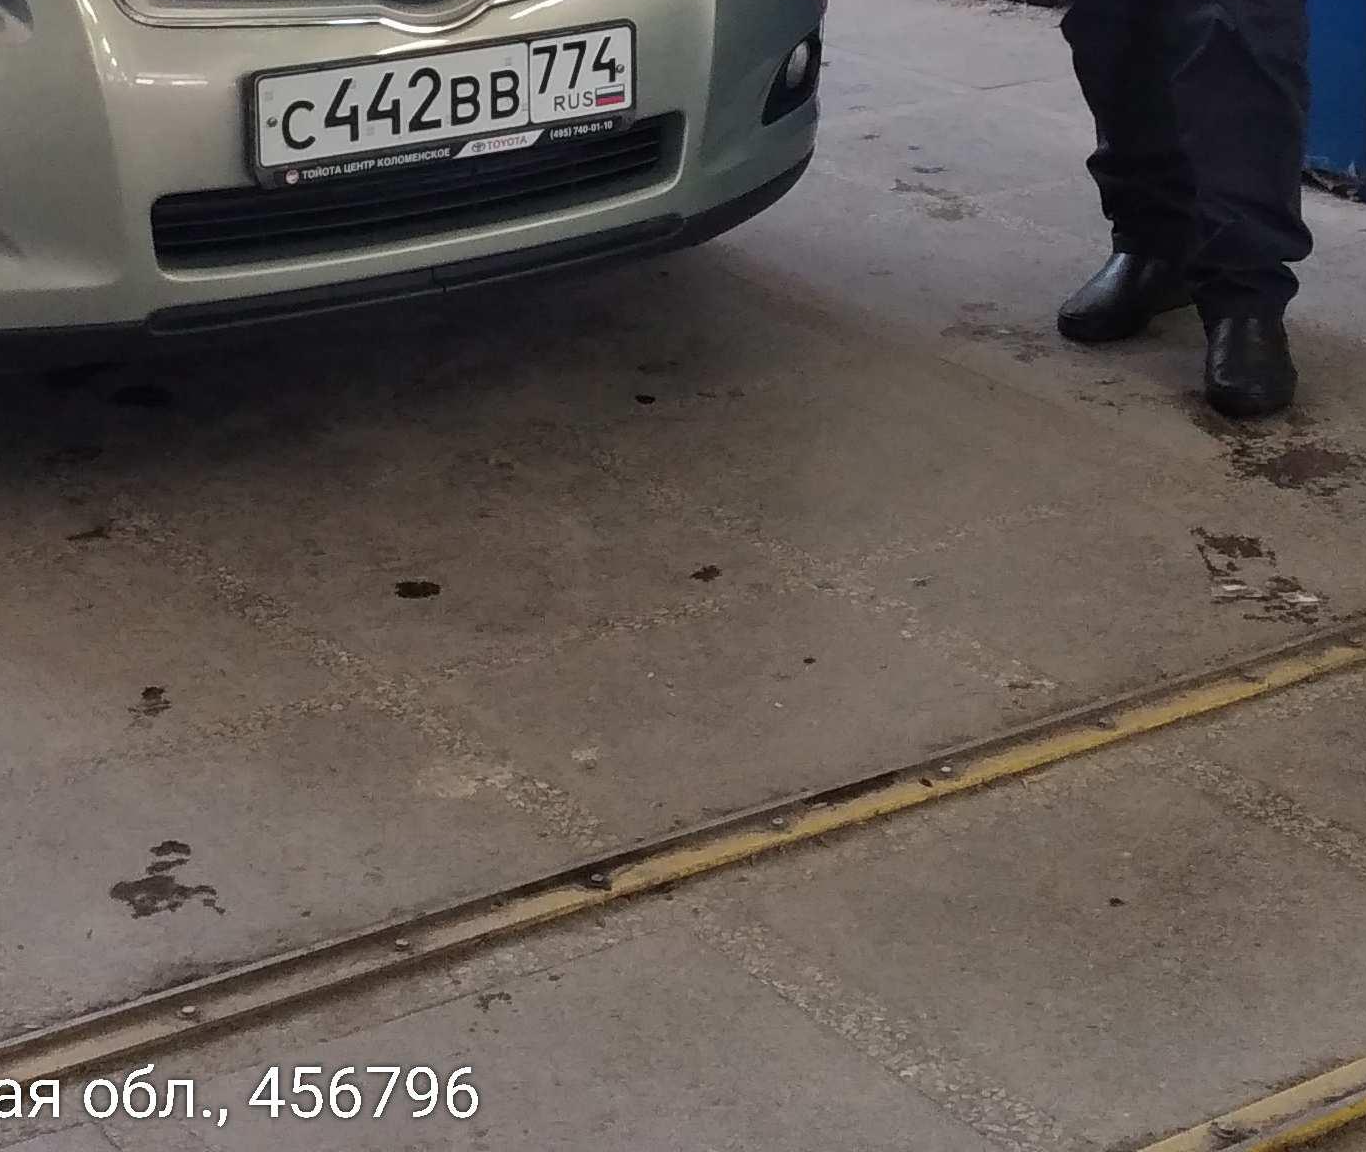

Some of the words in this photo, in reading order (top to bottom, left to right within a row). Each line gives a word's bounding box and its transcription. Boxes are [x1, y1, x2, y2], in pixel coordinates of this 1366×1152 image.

[281, 67, 520, 150] С442ВВ
[531, 36, 617, 95] 774
[554, 92, 594, 111] RUS
[487, 135, 528, 151] TOYOTA
[301, 164, 342, 180] ТОЙОТА
[343, 159, 376, 174] ЦЕНТР
[377, 147, 450, 168] КОЛОМЕНСКОЕ
